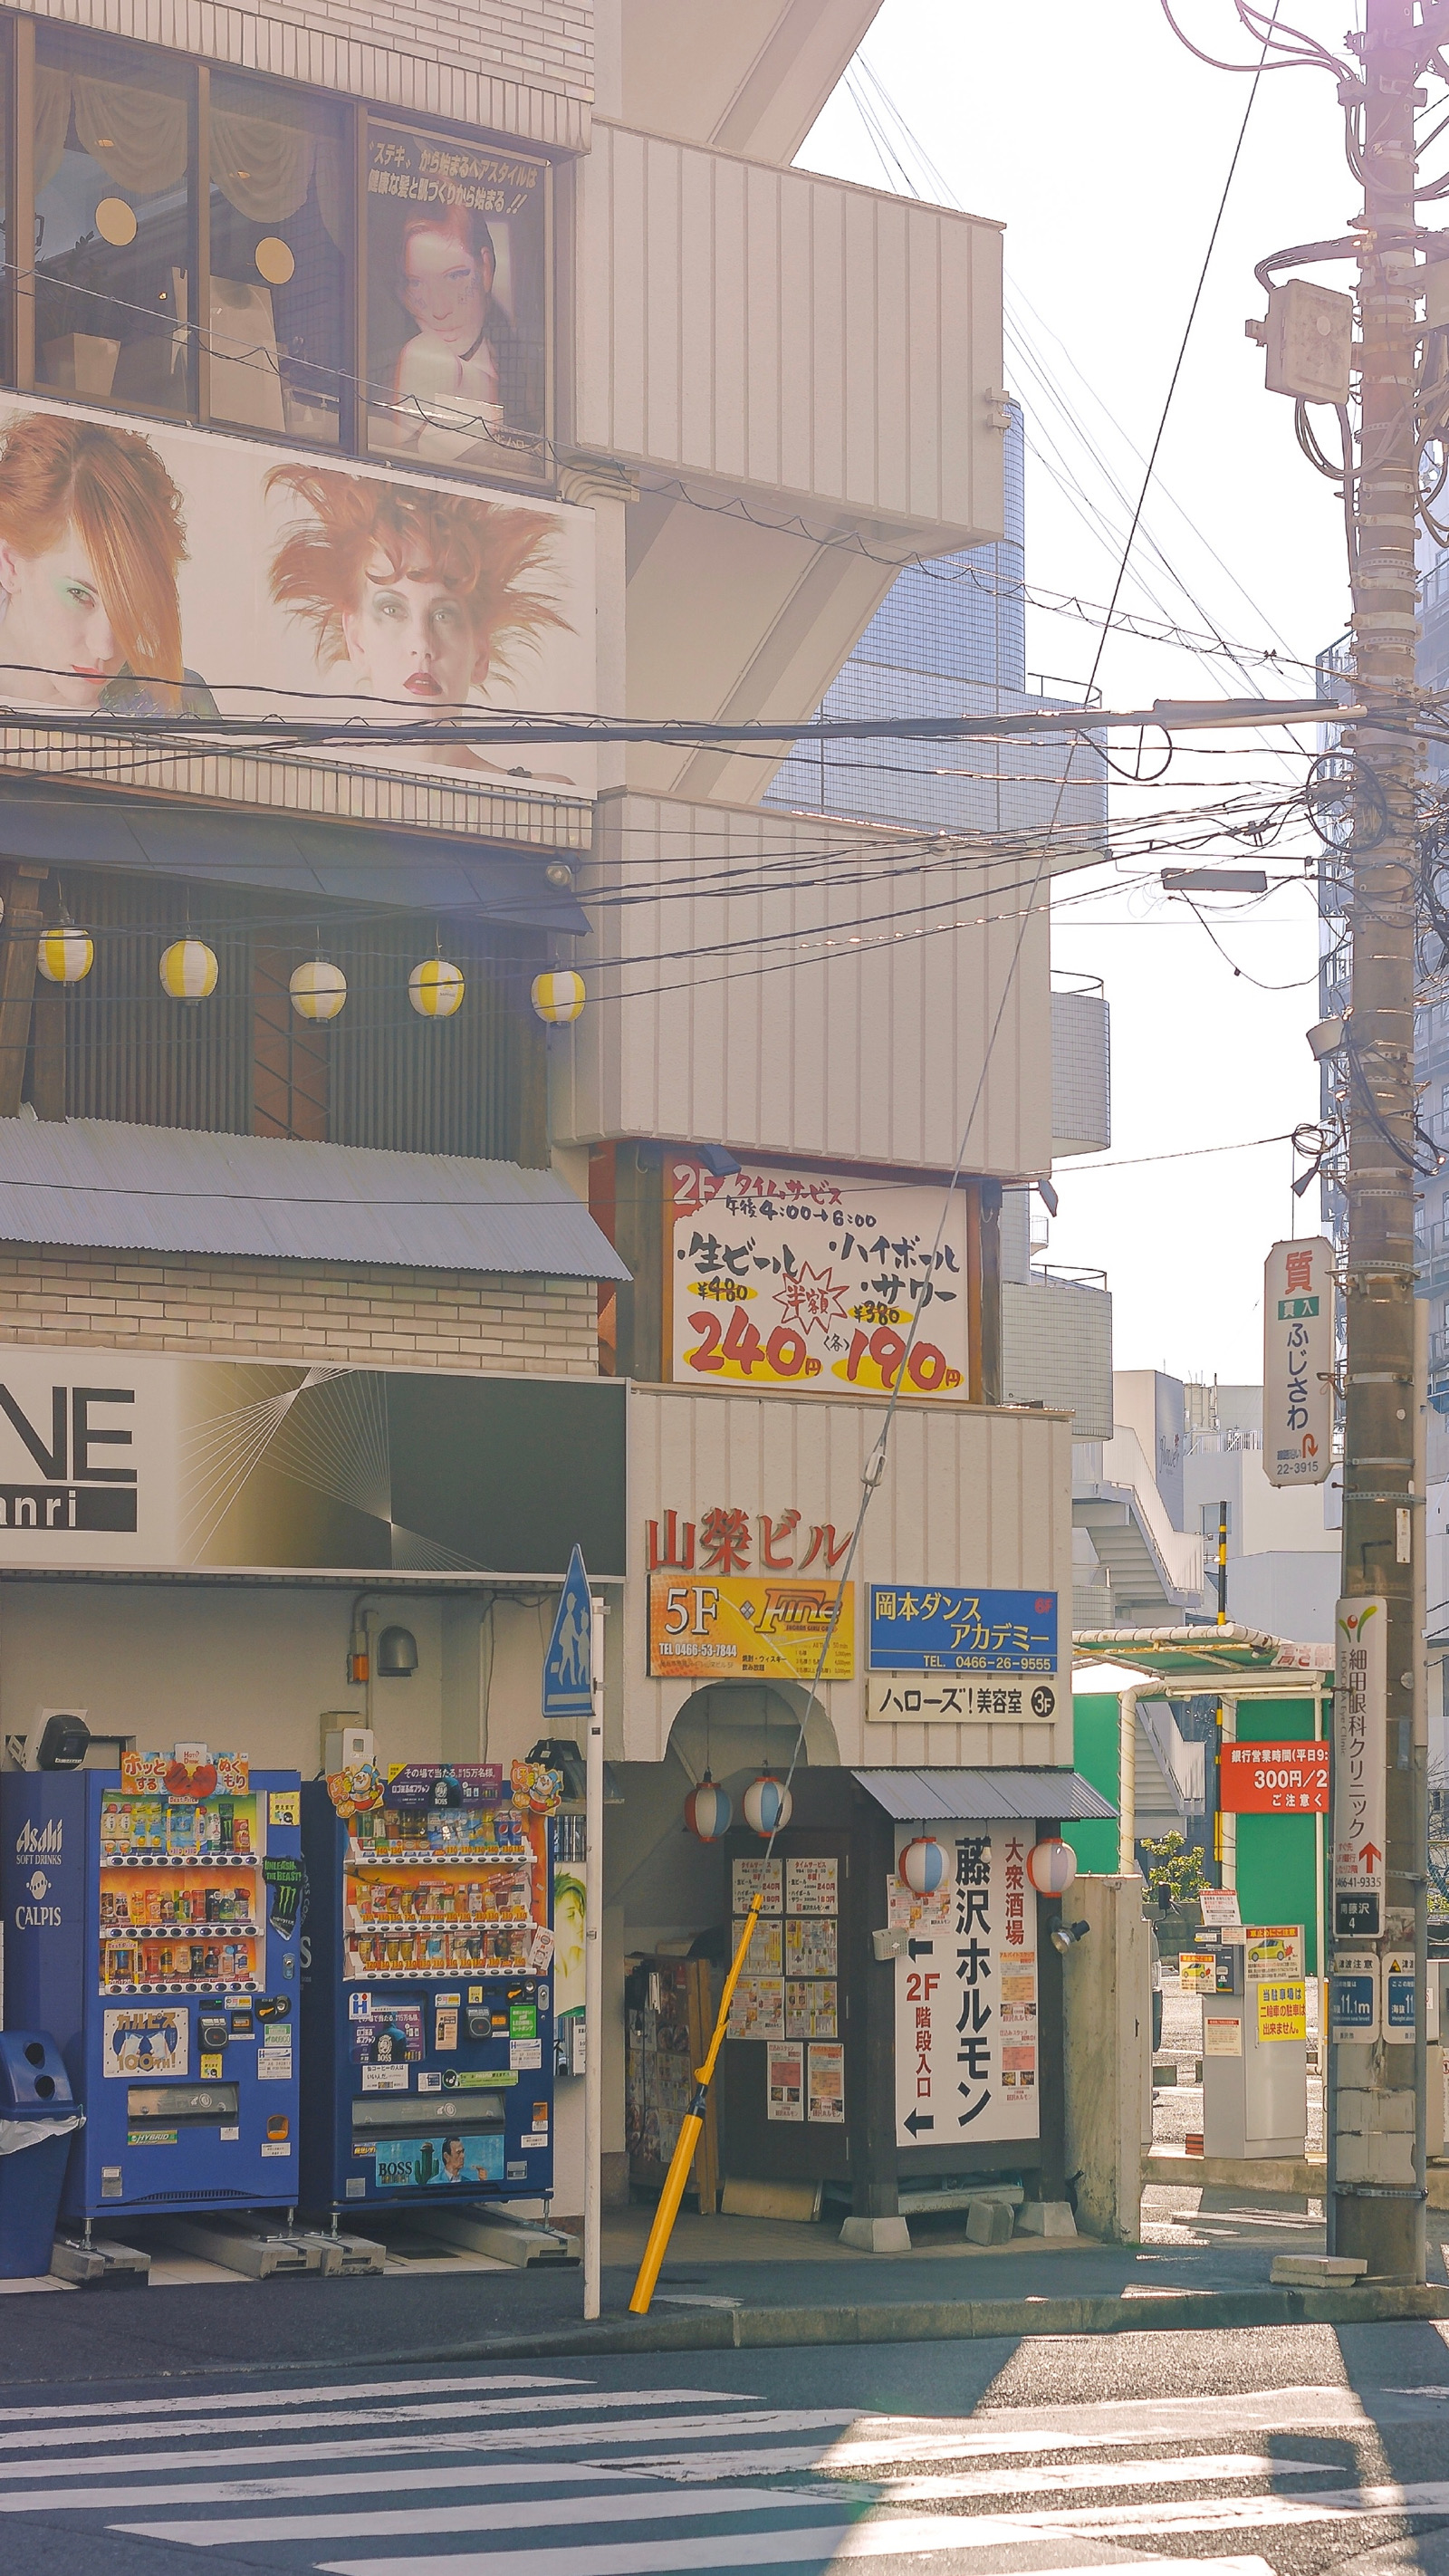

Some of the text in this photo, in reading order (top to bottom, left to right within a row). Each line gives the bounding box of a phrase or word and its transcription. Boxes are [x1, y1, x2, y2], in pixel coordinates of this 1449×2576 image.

[673, 1164, 724, 1206] 2F
[735, 1172, 842, 1205] タイムサービス
[1285, 1249, 1313, 1295] 質
[697, 1276, 748, 1302] ¥480
[786, 1283, 829, 1315] 半額
[854, 1301, 900, 1326] ¥380
[1283, 1301, 1314, 1318] 買入
[688, 1305, 821, 1377] 240円
[846, 1326, 961, 1391] 190円
[1287, 1322, 1310, 1431] ふじさわ
[1277, 1460, 1319, 1475] 22-3915
[665, 1586, 719, 1635] 5F
[875, 1591, 982, 1622] 岡本ダンス
[1034, 1597, 1053, 1614] 6F
[951, 1622, 1050, 1651] アカデミー
[658, 1643, 737, 1657] TEL 0466-53-7844
[923, 1655, 1051, 1670] TEL. 0466-26-9555
[1033, 1690, 1051, 1714] 3F
[1348, 1648, 1367, 1840] 細田眼科クリニック
[125, 1754, 167, 1775] ホッと
[219, 1758, 240, 1773] ぬく
[136, 1777, 158, 1791] する
[224, 1774, 245, 1789] もり
[16, 1819, 62, 1852] Asahi
[16, 1854, 62, 1865] SOFT DRINKS
[1004, 1837, 1024, 1946] 大衆酒場
[15, 1906, 62, 1930] CALPIS
[1348, 1918, 1355, 1928] 4
[906, 1973, 941, 2001] 2F
[955, 1836, 993, 2129] 藤沢ホルモン
[1263, 1989, 1301, 2002] 当駐車場は
[1341, 1994, 1370, 2014] 11.1m
[117, 2013, 176, 2030] カルピス
[1261, 2004, 1305, 2018] 二輪車の駐車は
[1262, 2022, 1300, 2036] 出来ません。
[378, 2053, 392, 2062] BOSS
[915, 2006, 932, 2098] 階段入口
[136, 2134, 168, 2143] HYBRID
[379, 2162, 412, 2176] BOSS
